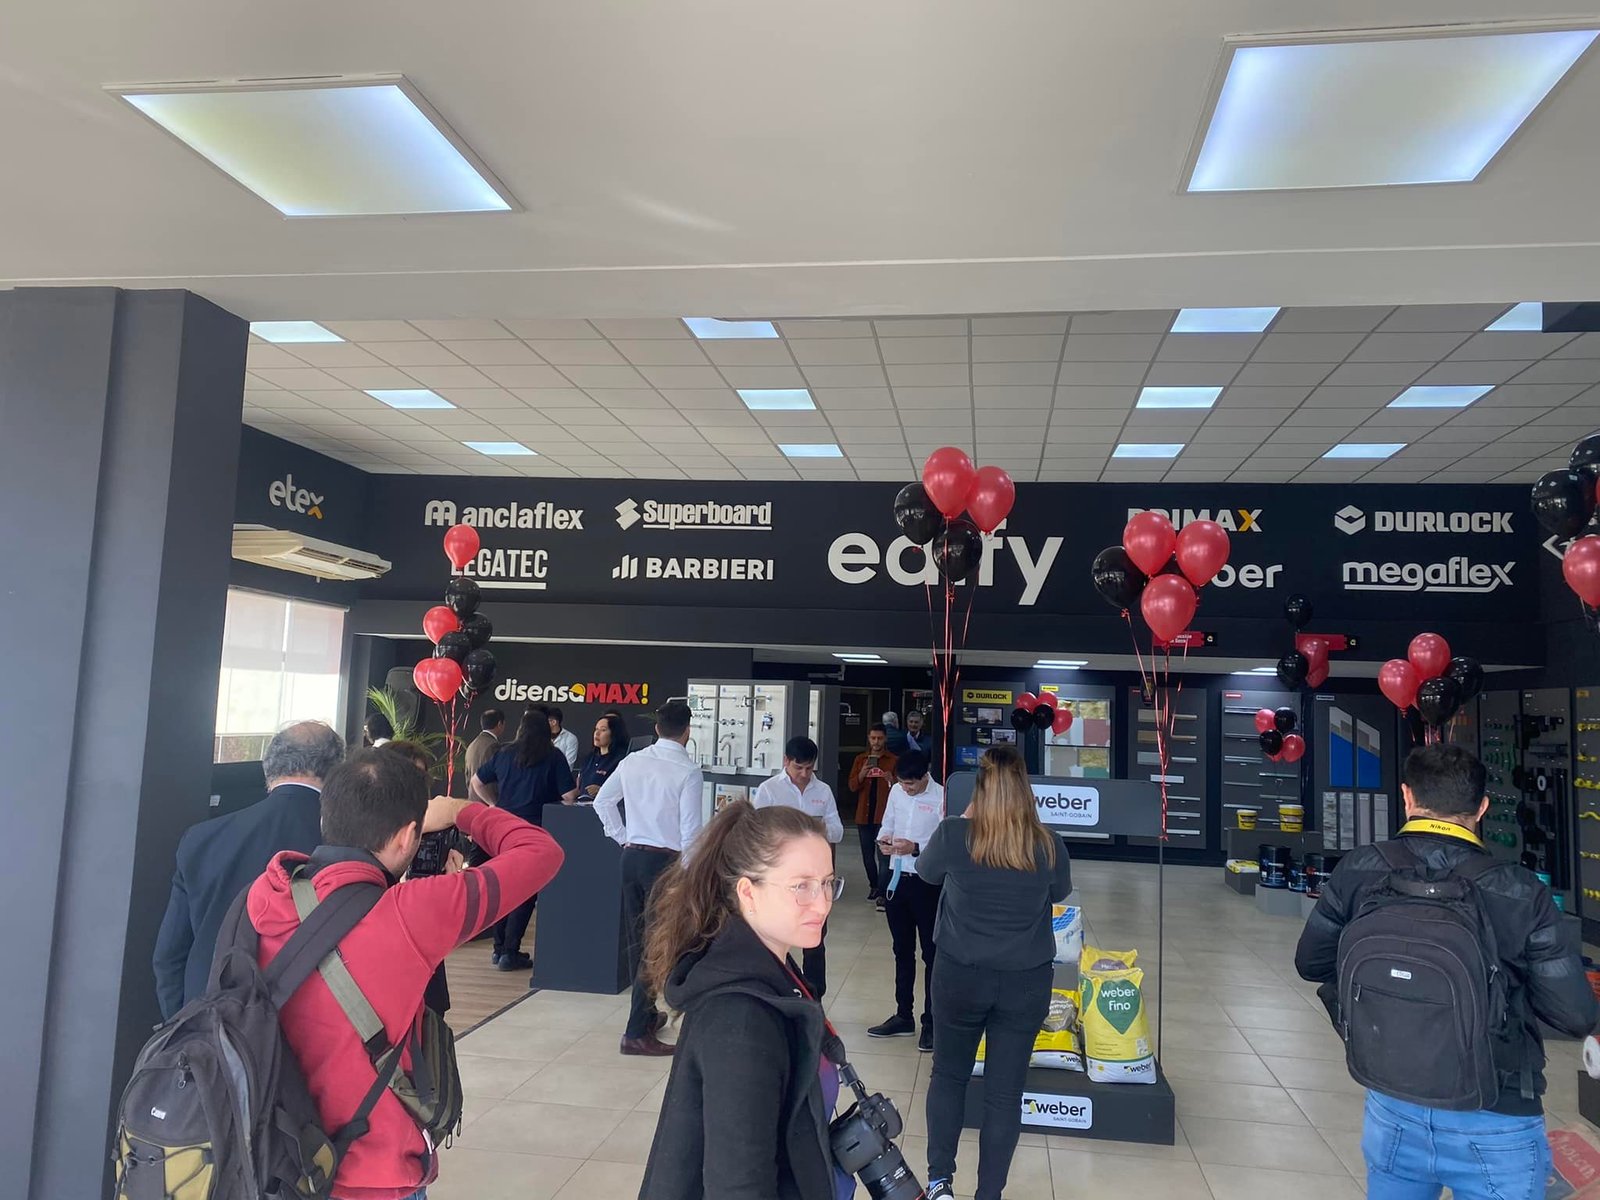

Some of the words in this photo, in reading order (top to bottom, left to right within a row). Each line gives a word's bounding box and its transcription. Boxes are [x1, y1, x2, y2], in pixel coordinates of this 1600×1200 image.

[269, 474, 324, 519] etex
[462, 502, 584, 530] anclaflex
[643, 500, 772, 530] Superboard
[1374, 511, 1514, 533] DURLOCK
[646, 557, 774, 580] BARBIERI
[1343, 557, 1516, 592] megaflex
[1101, 987, 1136, 998] weber
[1108, 1000, 1131, 1011] fino
[1130, 1062, 1152, 1073] weber
[1036, 1101, 1087, 1117] weber
